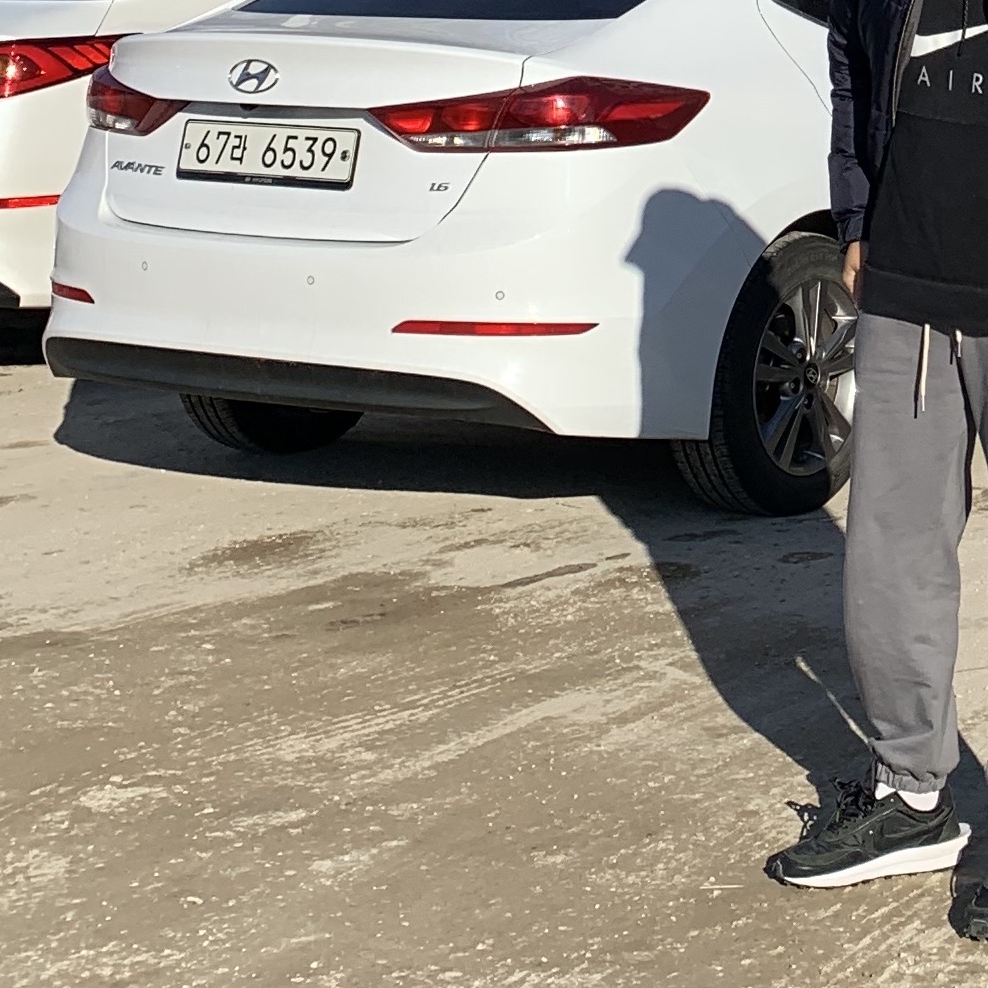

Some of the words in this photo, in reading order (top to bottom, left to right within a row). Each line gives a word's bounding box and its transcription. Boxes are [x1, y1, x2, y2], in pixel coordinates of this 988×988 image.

[916, 65, 984, 94] AIR
[195, 129, 248, 166] 67라
[261, 133, 338, 173] 6539
[110, 160, 166, 176] AVANTE
